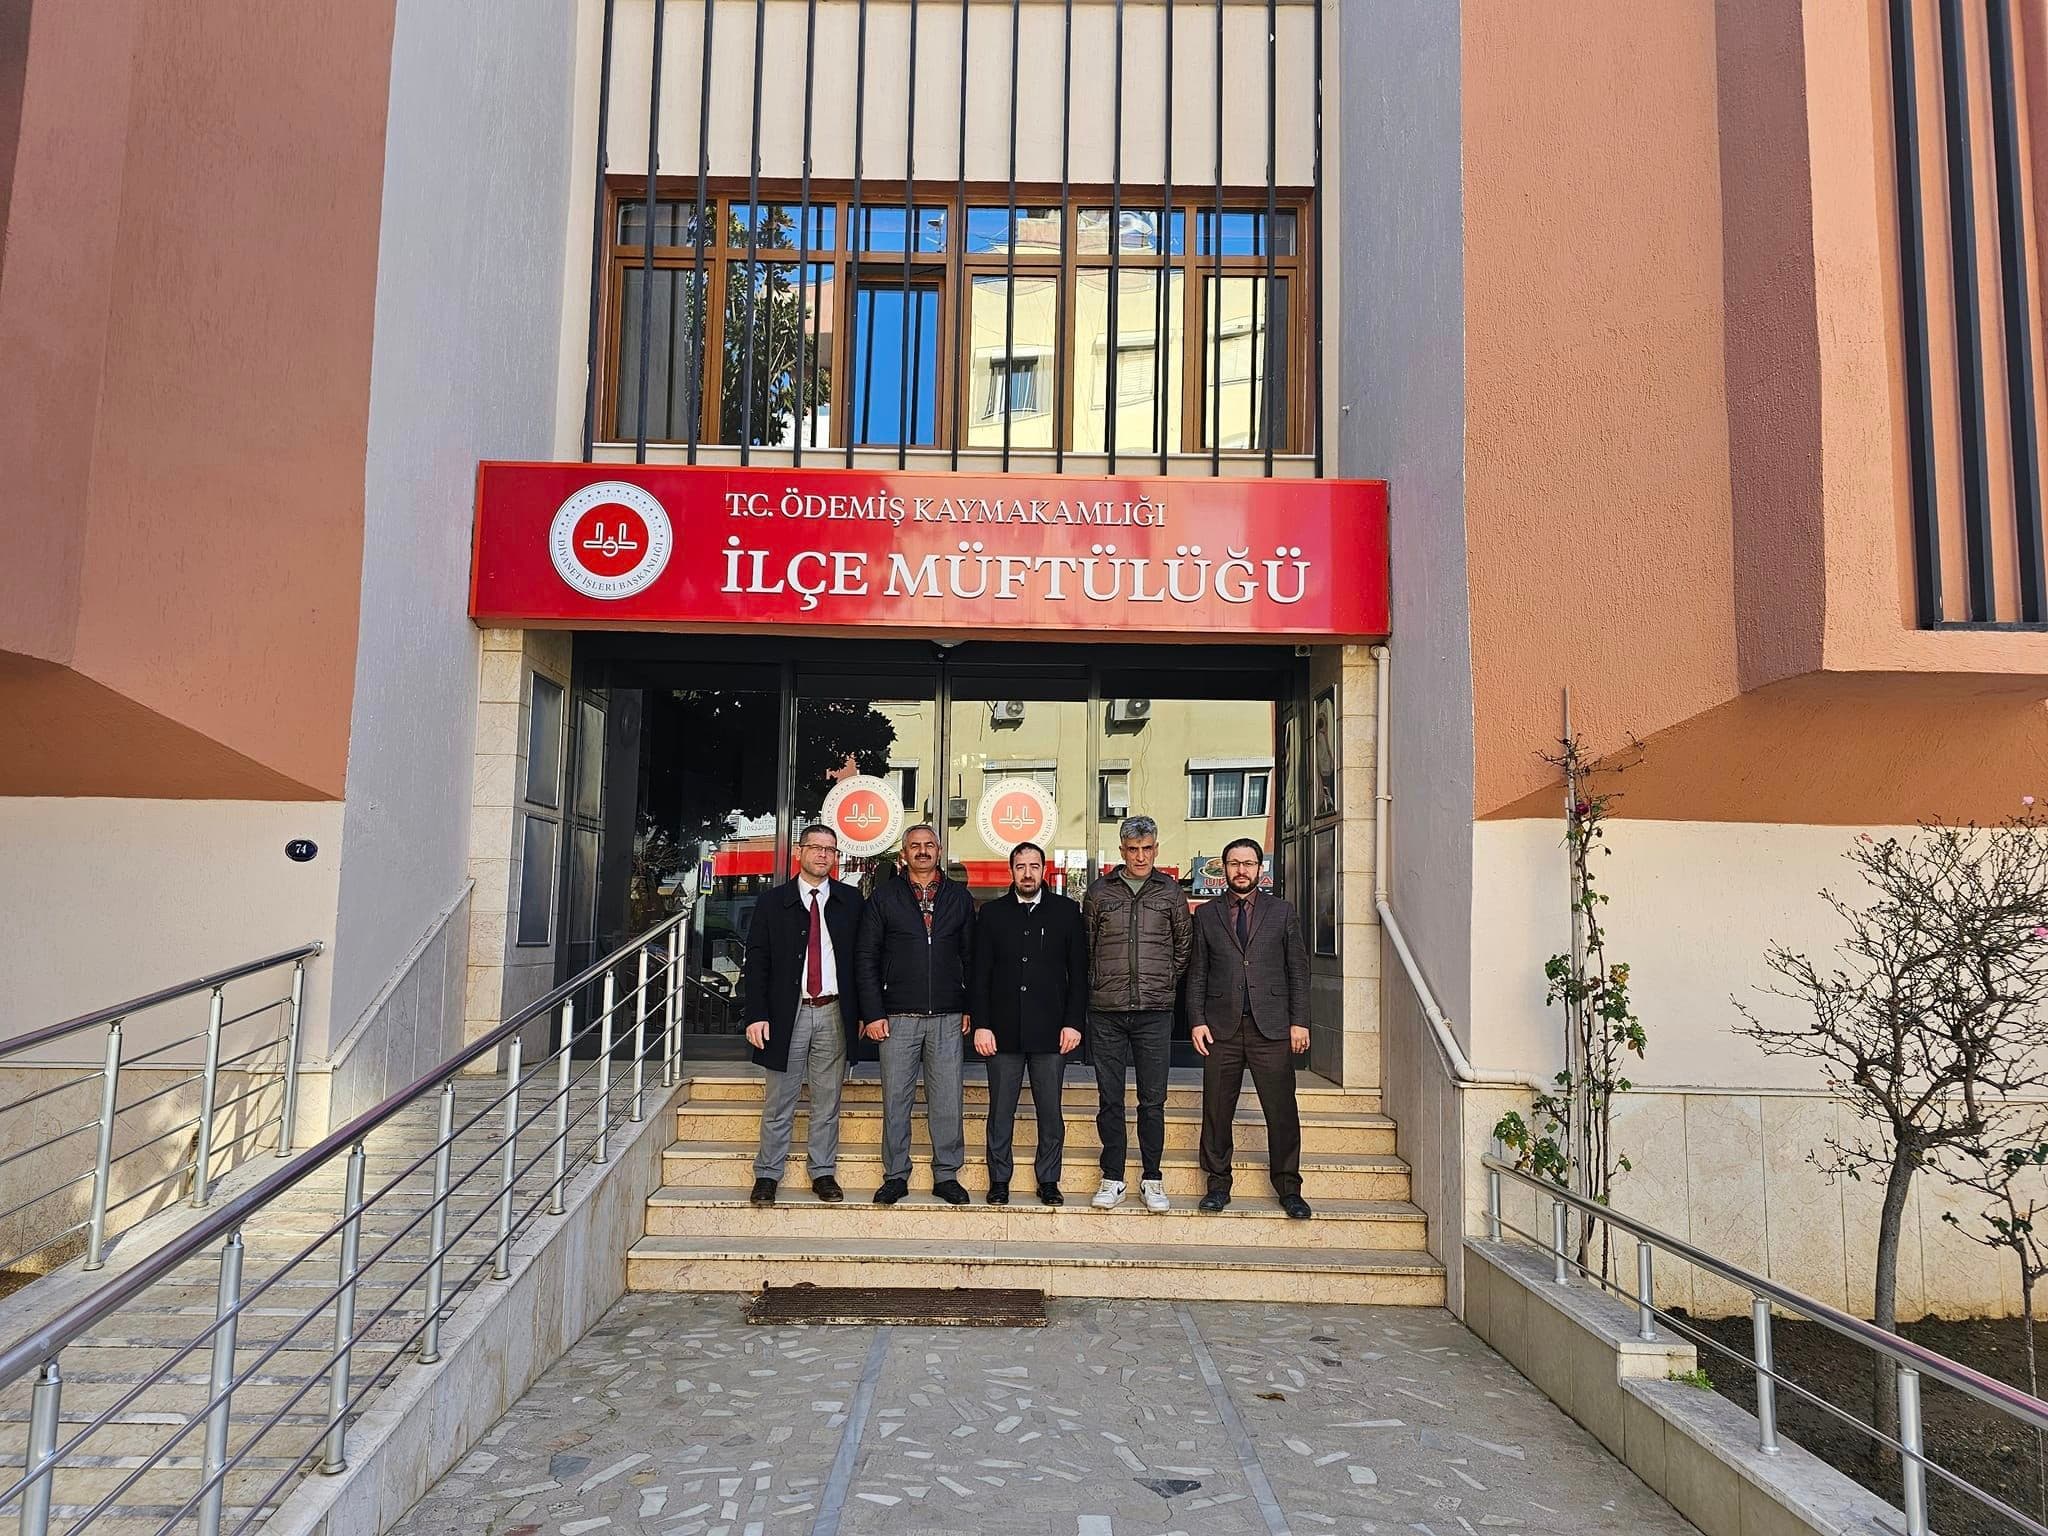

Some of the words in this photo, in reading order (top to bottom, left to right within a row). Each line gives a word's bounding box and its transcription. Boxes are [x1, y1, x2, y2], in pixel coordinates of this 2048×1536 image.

[725, 493, 774, 517] T.C.
[780, 487, 906, 527] ÖDEMİŞ
[913, 495, 1166, 527] KAYMAKAMLIĞI
[557, 539, 583, 581] DİYANET
[582, 576, 617, 592] İŞLERİ
[618, 541, 664, 590] BAŞKANLIĞI
[720, 535, 869, 611] İLÇE
[882, 541, 1311, 604] MÜFTÜLÜĞÜ
[295, 843, 307, 854] 74
